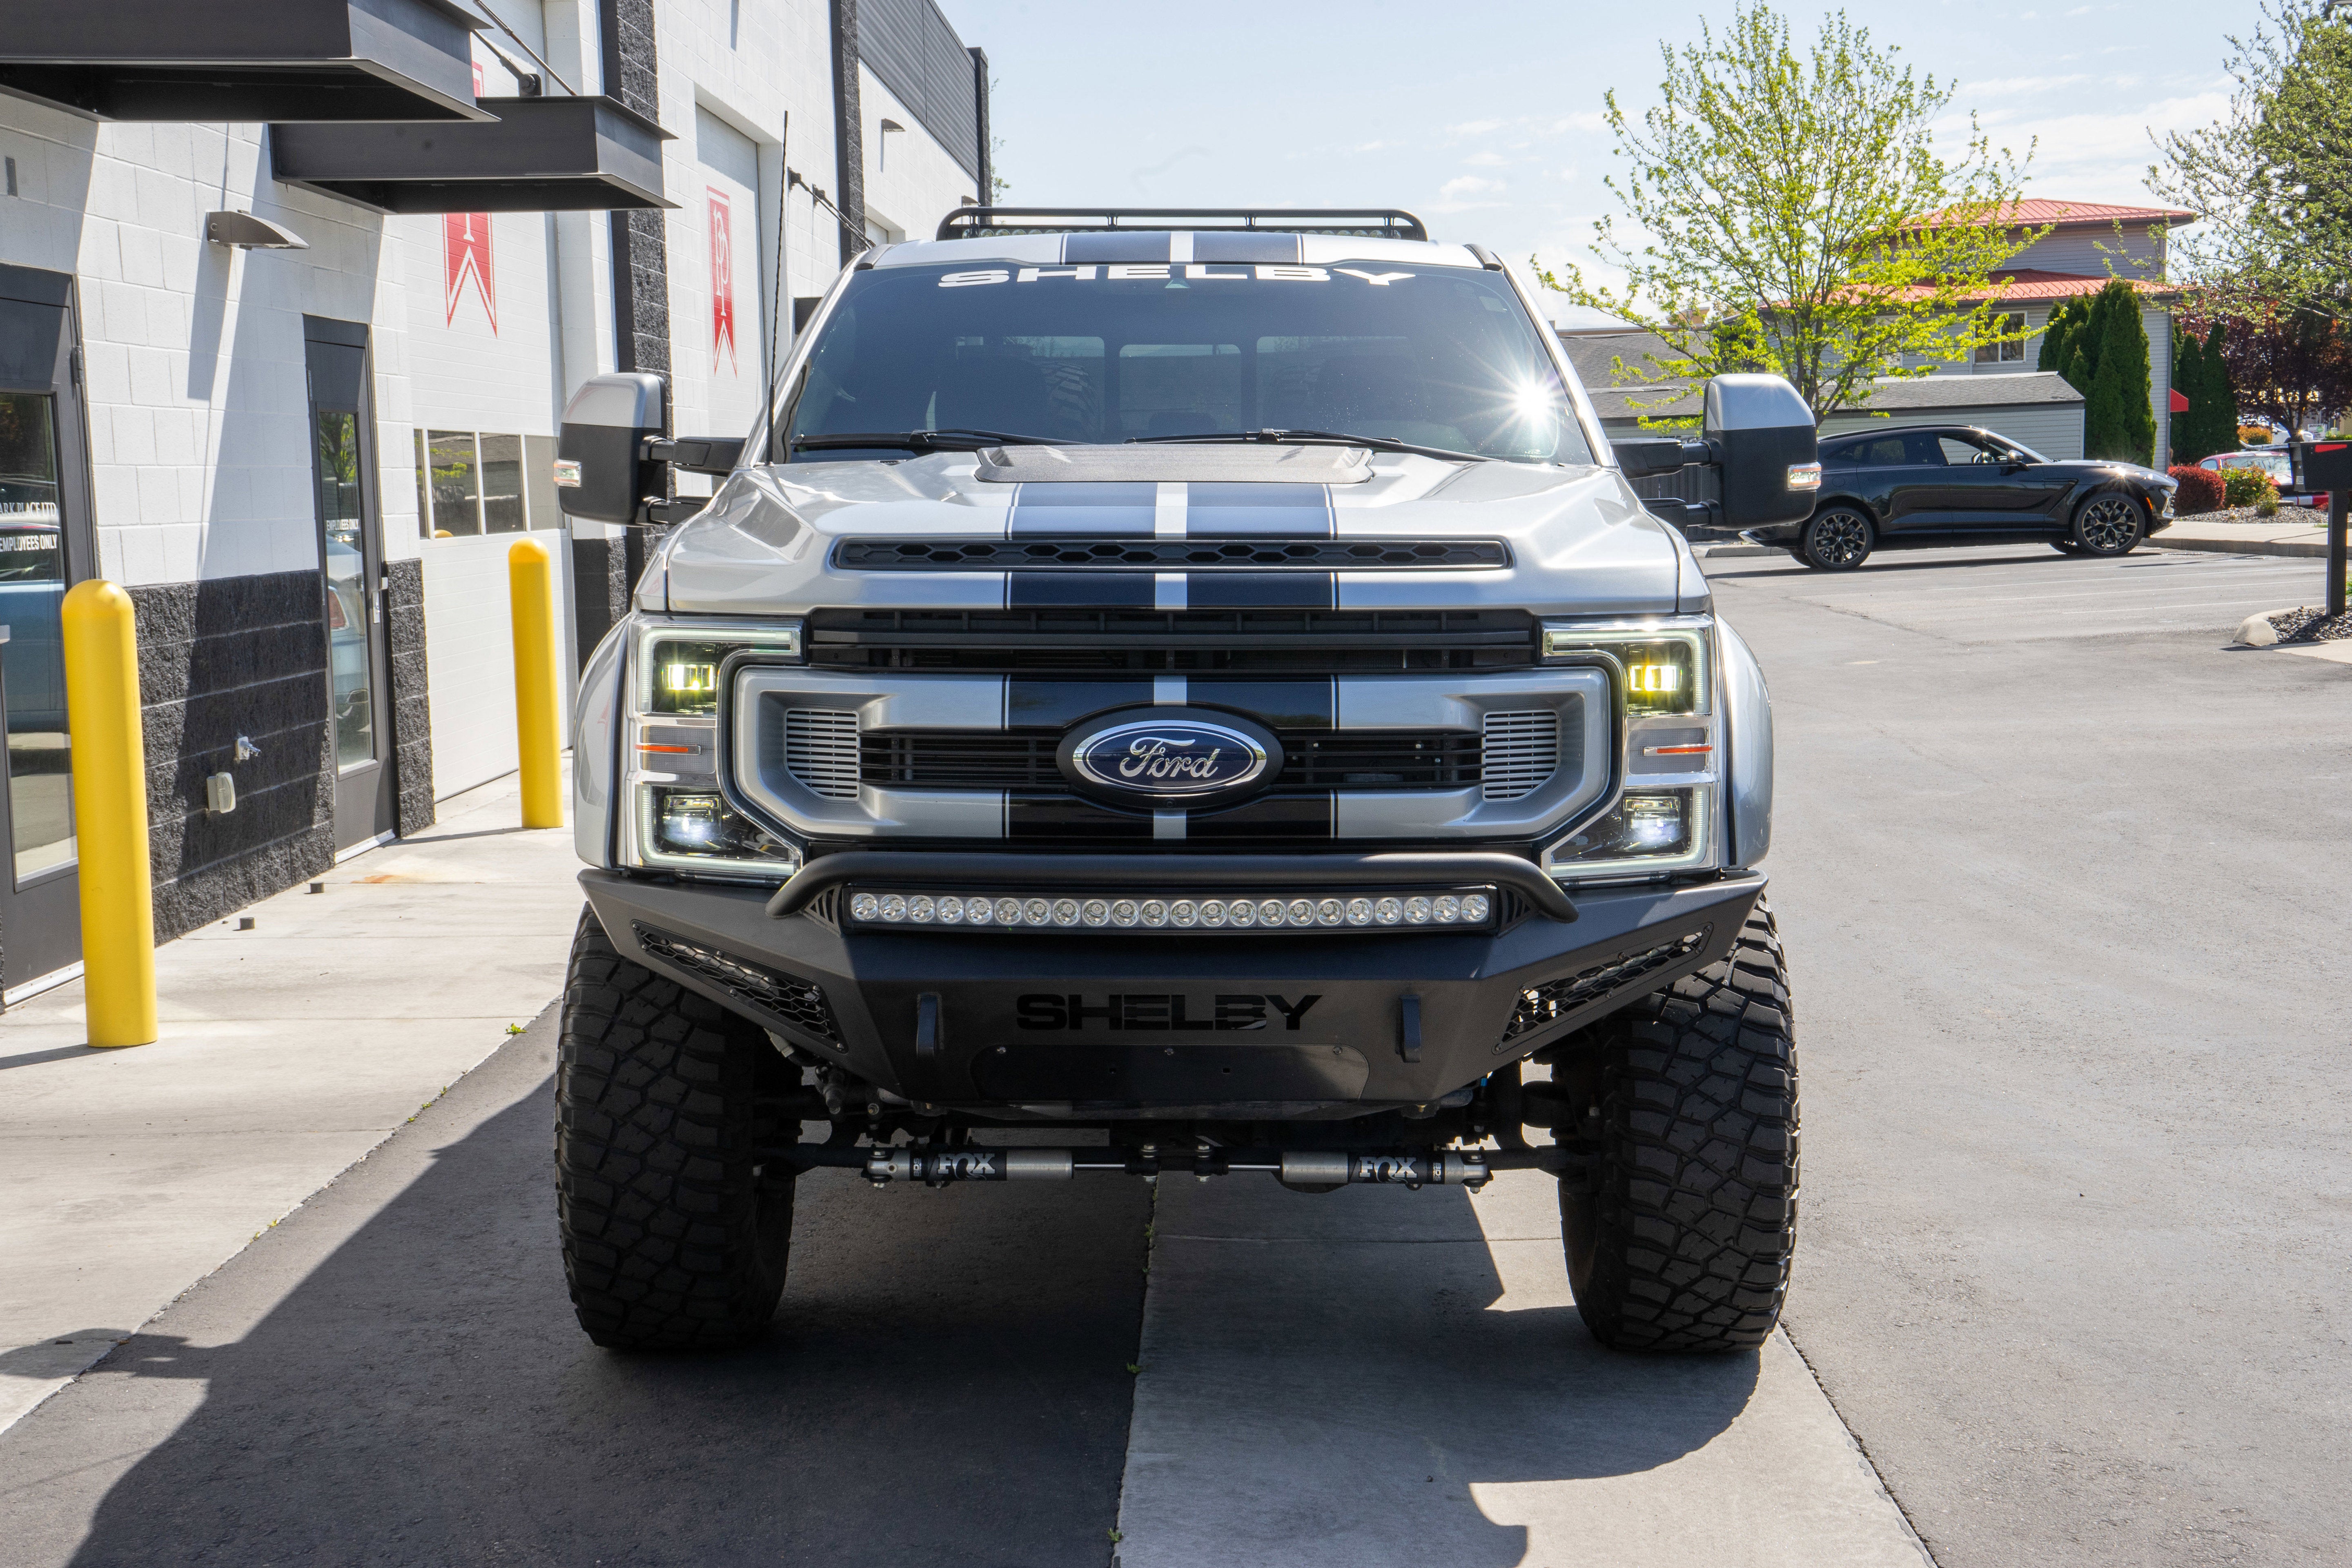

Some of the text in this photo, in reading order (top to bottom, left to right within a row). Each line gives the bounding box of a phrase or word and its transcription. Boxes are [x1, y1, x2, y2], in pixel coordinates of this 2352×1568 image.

[938, 265, 1416, 287] SHELBY
[17, 502, 40, 516] PLACE
[41, 502, 57, 517] LTD
[326, 519, 359, 531] EMPLOYEES ONLY
[0, 534, 57, 552] EMPLOYEES ONLY
[1120, 737, 1221, 777] Ford
[1016, 994, 1323, 1030] SHELBY
[938, 1152, 995, 1180] FOX
[1359, 1156, 1417, 1183] FOX
